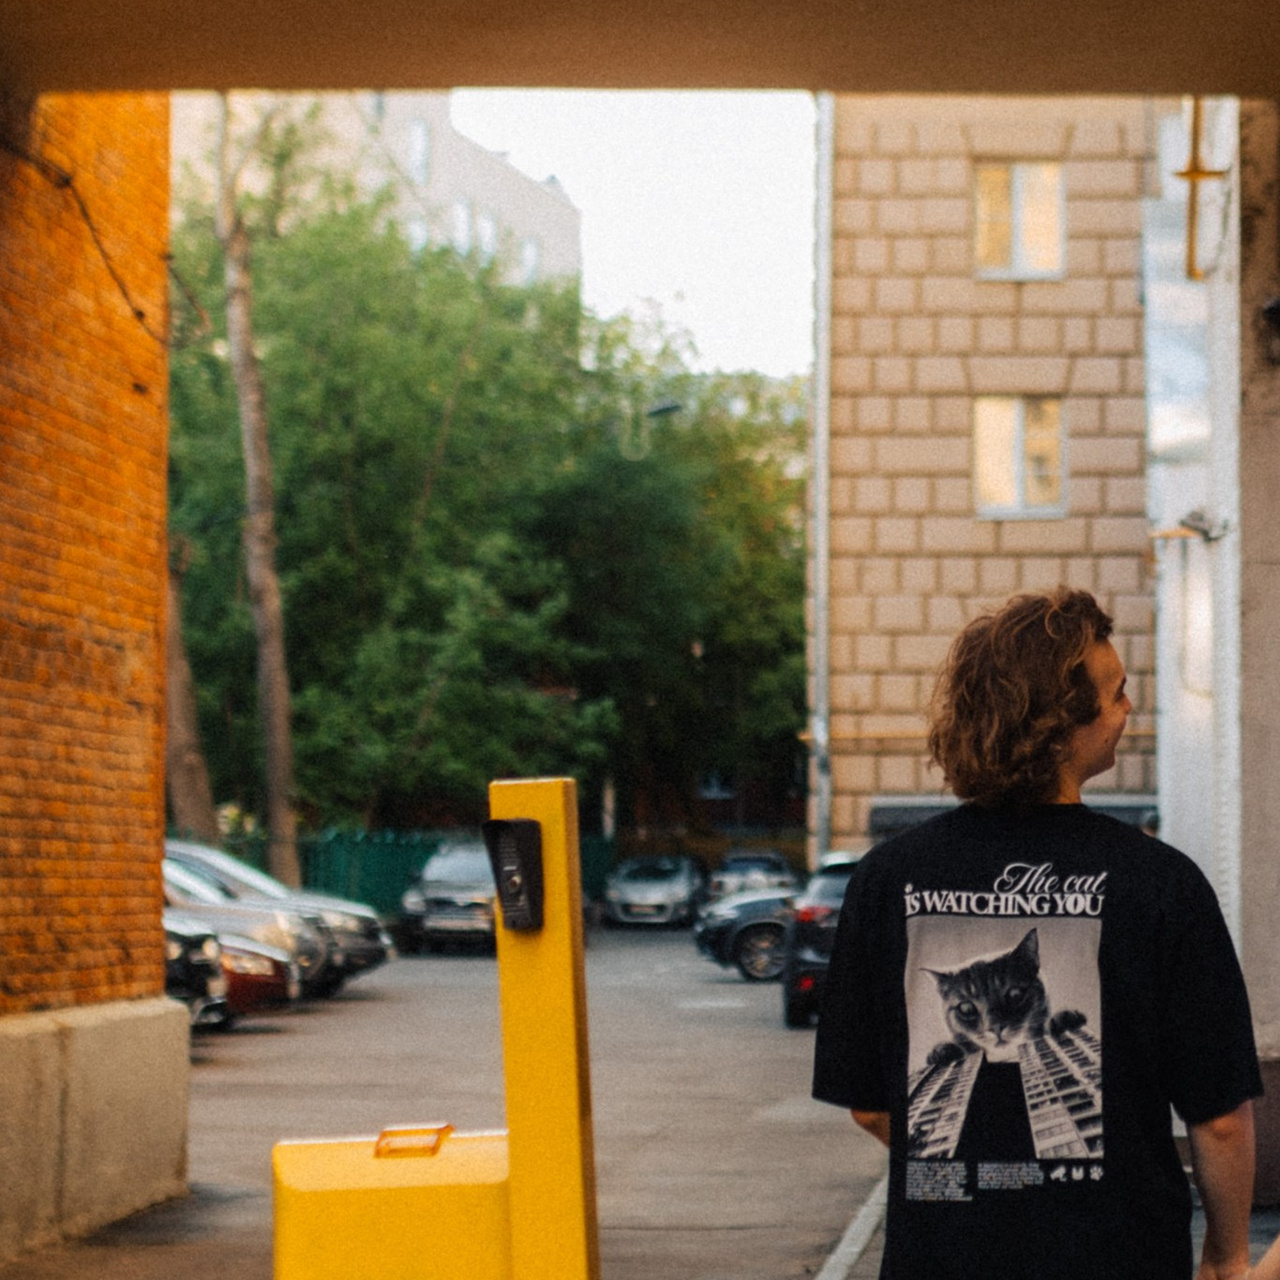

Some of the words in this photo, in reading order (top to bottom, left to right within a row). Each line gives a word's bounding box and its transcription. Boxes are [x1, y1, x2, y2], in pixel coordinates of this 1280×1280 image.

[994, 862, 1059, 895] The
[1064, 871, 1108, 895] cat
[923, 891, 1050, 915] WATCHING
[1053, 893, 1104, 916] YOU
